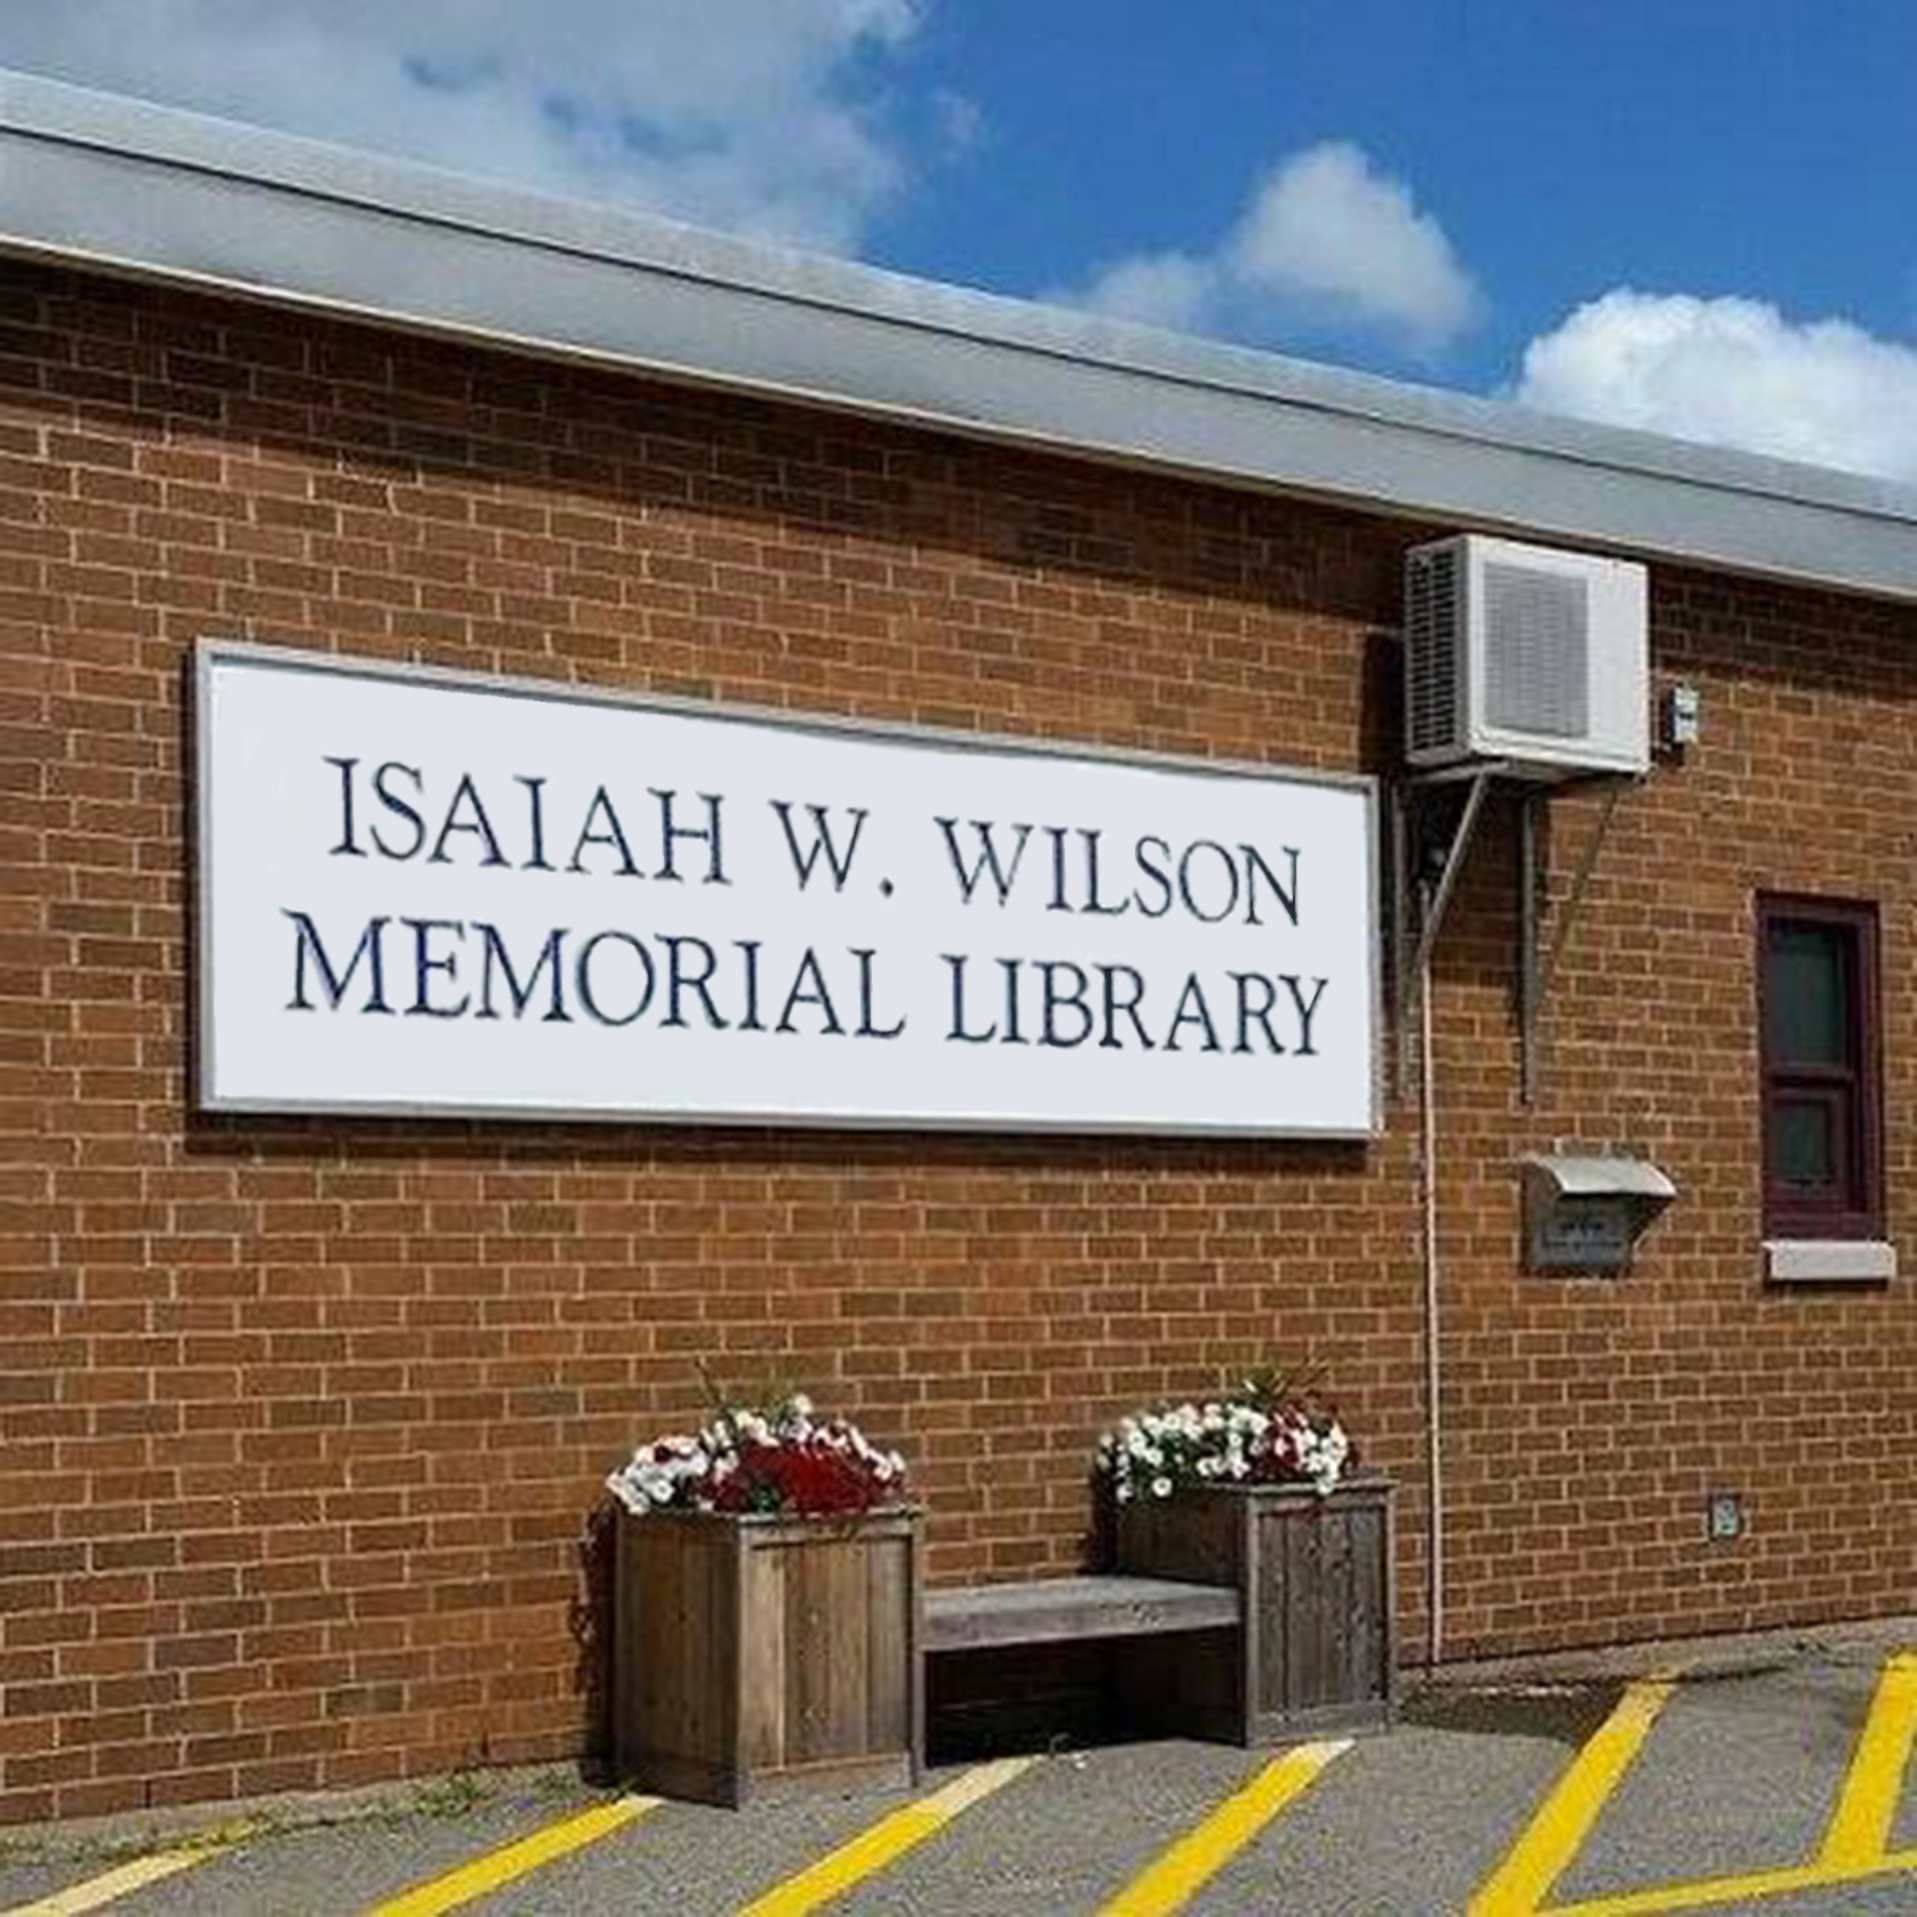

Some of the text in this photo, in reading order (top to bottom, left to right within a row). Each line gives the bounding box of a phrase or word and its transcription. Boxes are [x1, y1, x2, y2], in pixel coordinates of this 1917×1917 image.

[323, 755, 1301, 926] ISAIAH W. WILSON
[282, 909, 1329, 1056] MEMORIAL LIBRARY
